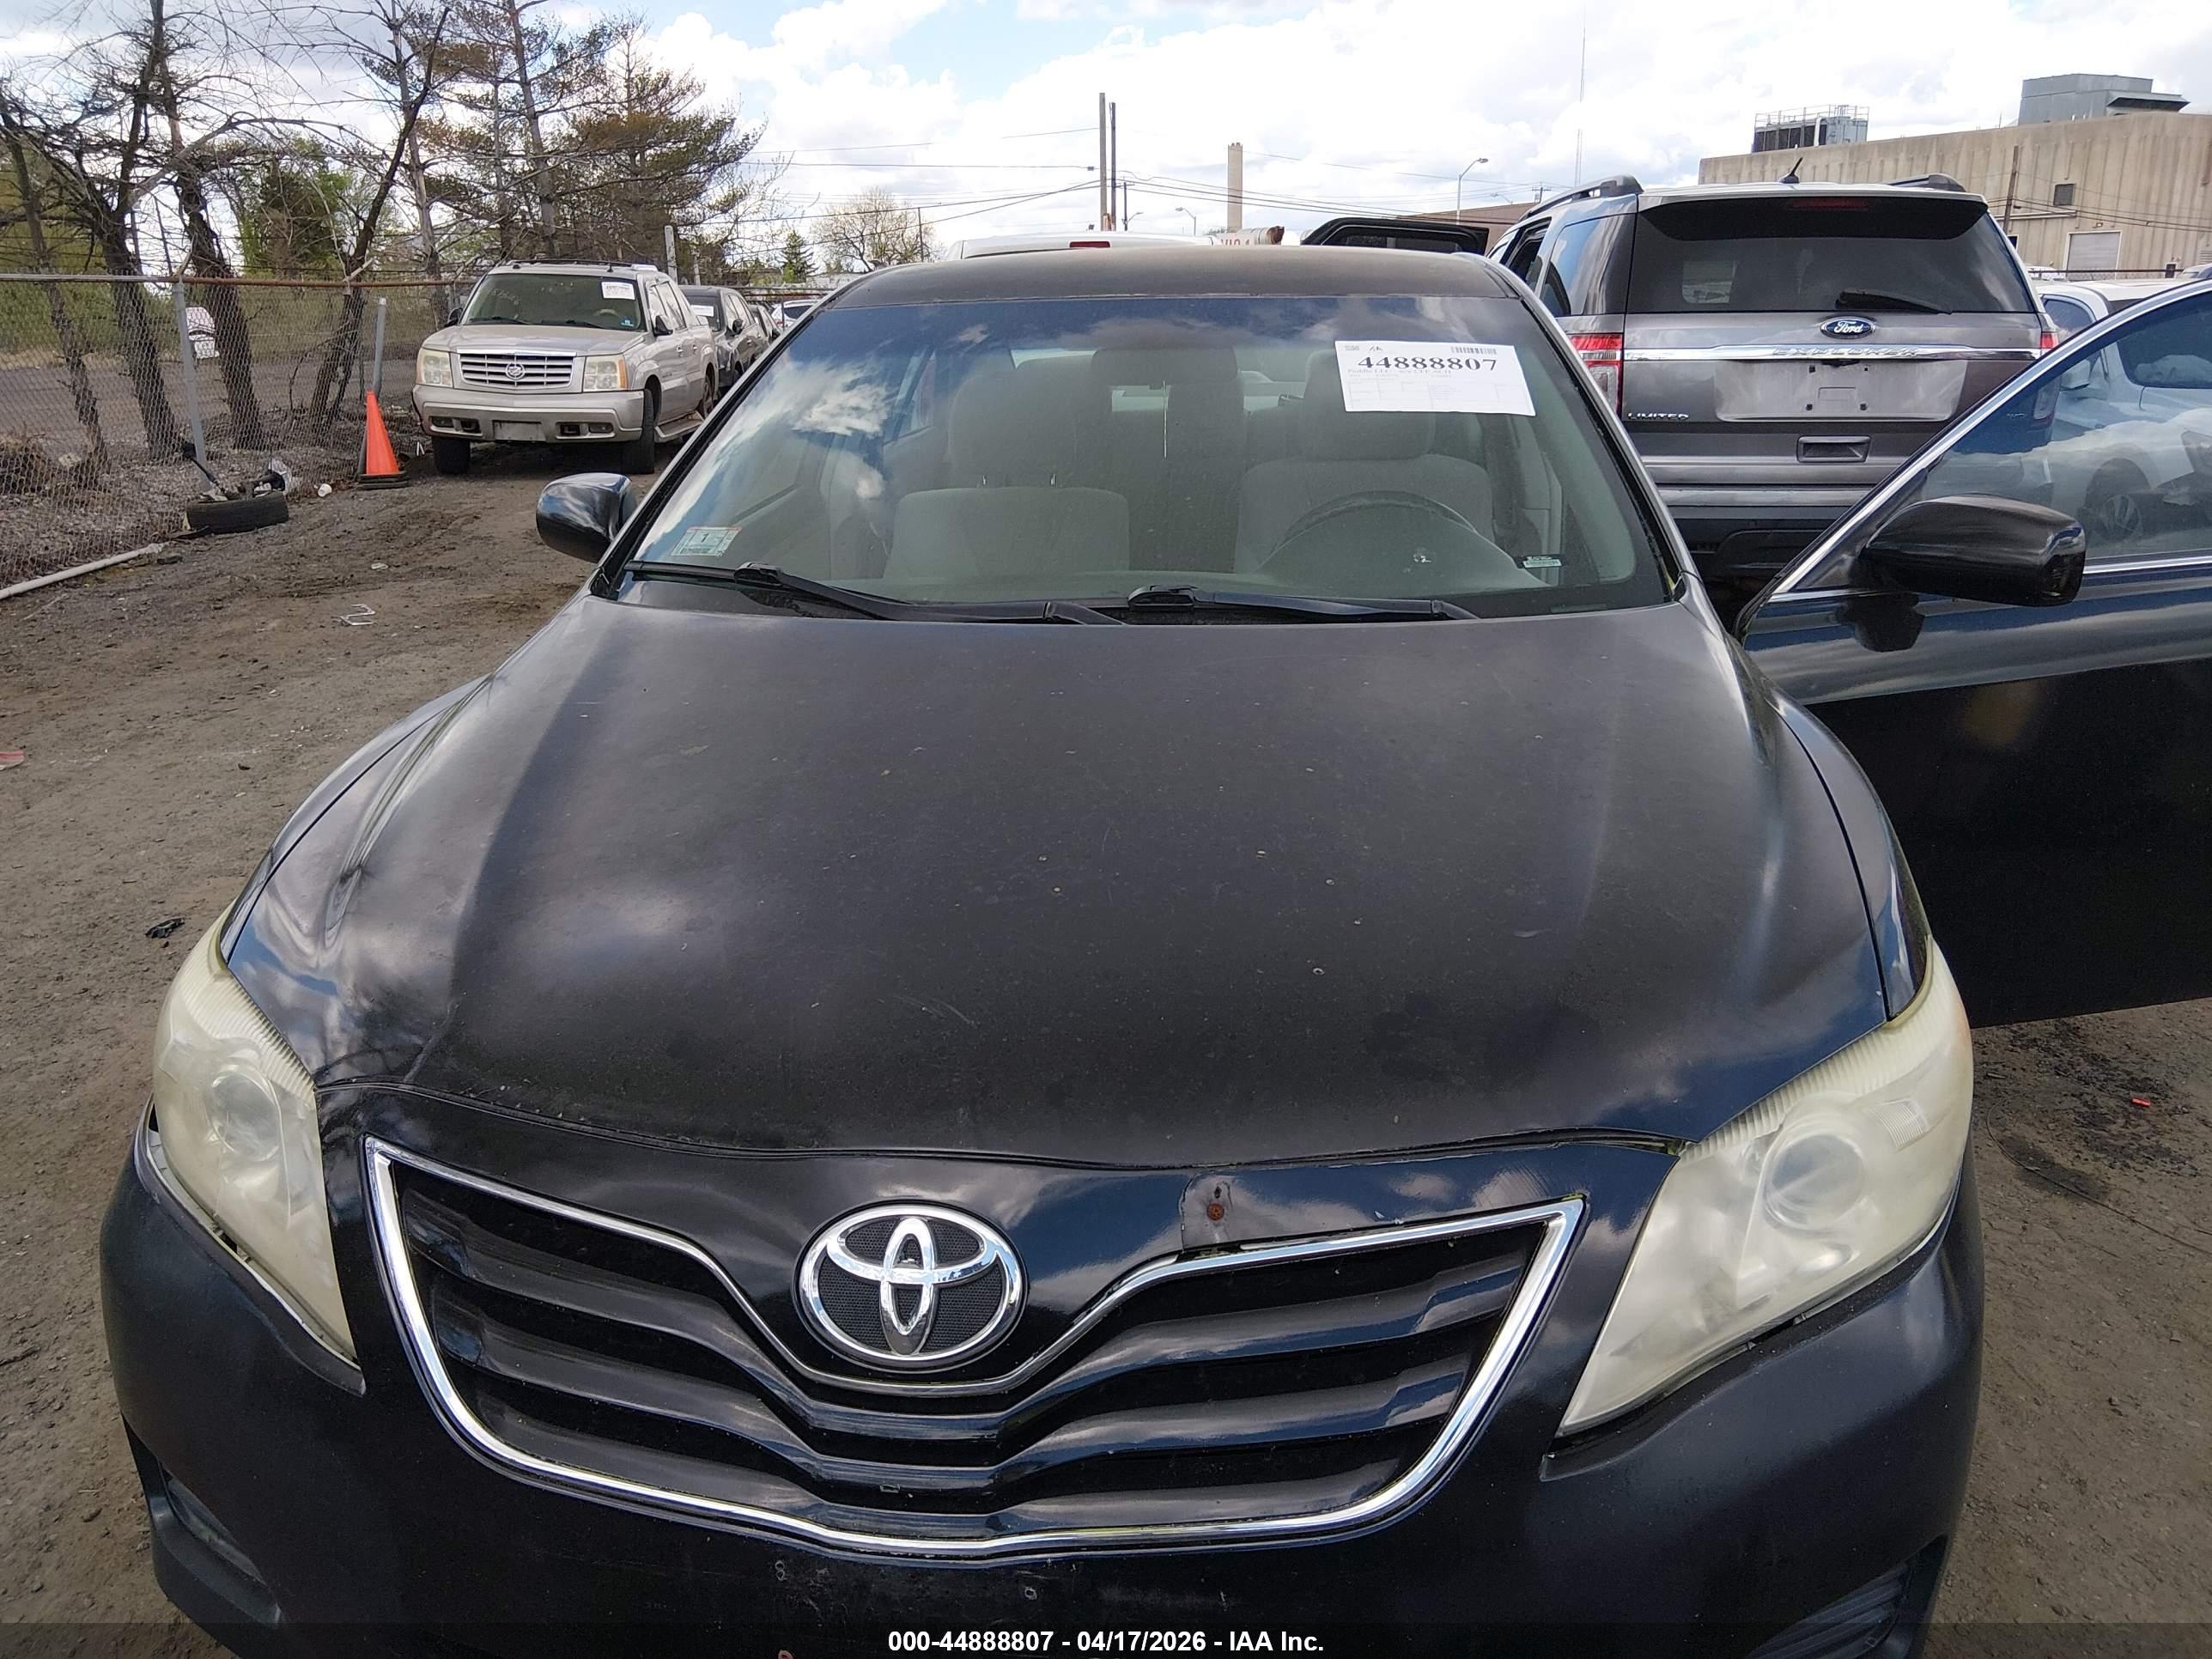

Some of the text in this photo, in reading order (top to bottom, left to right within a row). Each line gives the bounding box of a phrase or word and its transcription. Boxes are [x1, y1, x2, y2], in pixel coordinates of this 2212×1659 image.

[1833, 320, 1863, 334] Ford
[1771, 347, 1918, 357] EXPLORER
[1357, 356, 1498, 371] 44888807
